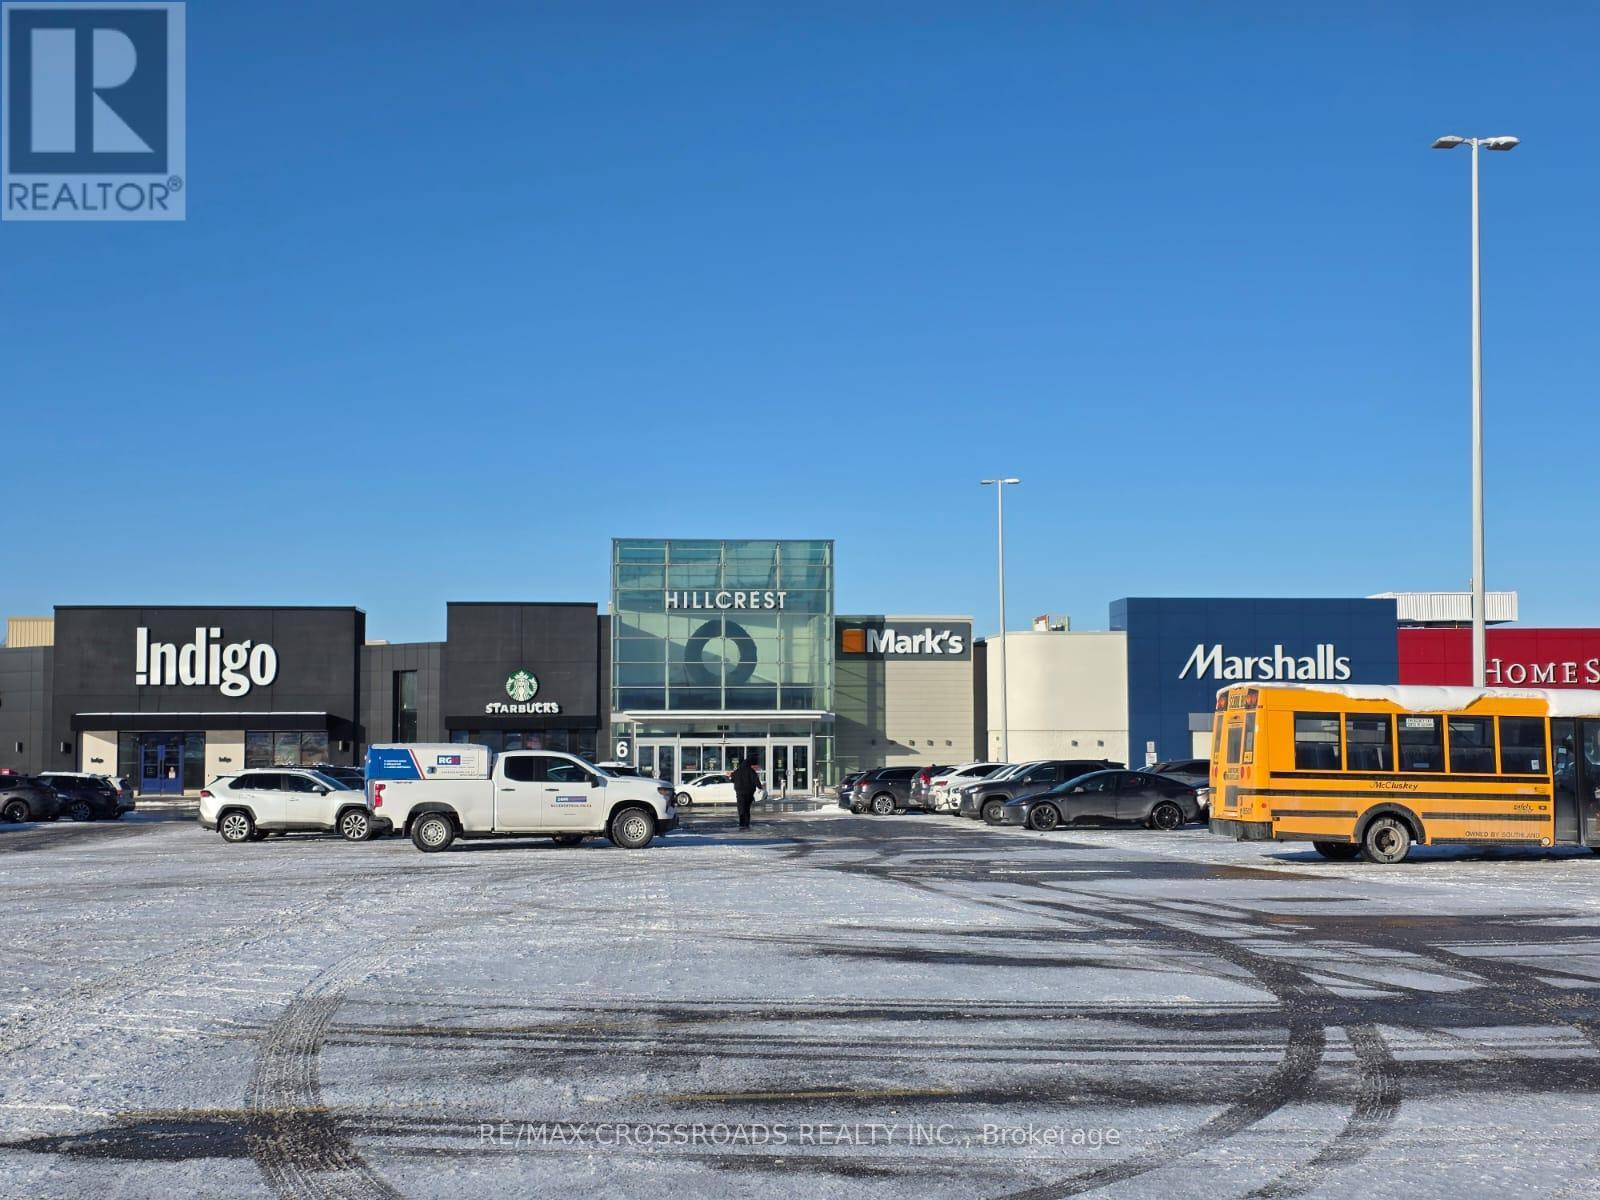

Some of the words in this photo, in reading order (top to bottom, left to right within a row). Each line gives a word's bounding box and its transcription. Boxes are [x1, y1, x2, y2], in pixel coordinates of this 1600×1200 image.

[665, 591, 788, 610] HILLCREST
[867, 627, 964, 655] Mark's
[1177, 643, 1351, 681] Marshalls
[485, 702, 560, 715] STARBUCKS
[616, 741, 629, 758] 6
